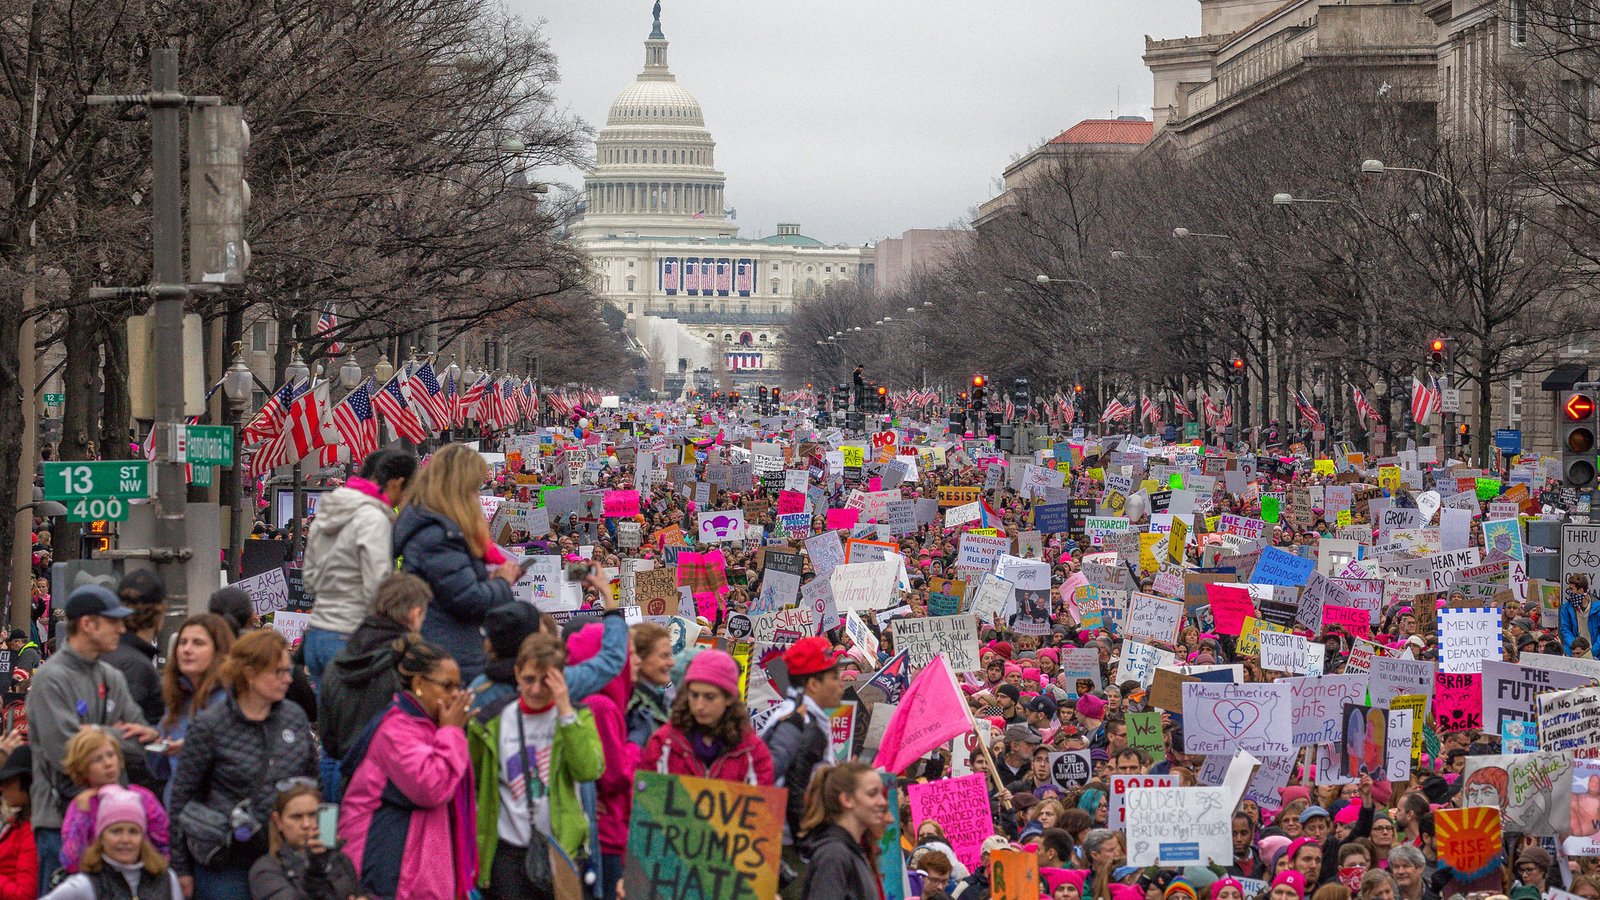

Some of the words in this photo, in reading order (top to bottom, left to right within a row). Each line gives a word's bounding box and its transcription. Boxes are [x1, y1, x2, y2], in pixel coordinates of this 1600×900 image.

[873, 431, 896, 448] HO
[59, 466, 93, 494] 13
[120, 469, 139, 479] ST
[1041, 470, 1057, 479] NEED
[1109, 476, 1131, 486] GRAB
[120, 483, 141, 493] NW
[938, 491, 980, 502] RESIST
[1356, 491, 1382, 503] LOVE
[73, 500, 122, 518] 400
[1087, 518, 1129, 530] PATRIARCHY
[1222, 515, 1239, 526] WE
[1245, 518, 1263, 530] ARE
[965, 536, 1007, 548] AMERICANS
[1567, 530, 1598, 543] THRU
[773, 553, 792, 564] HATE
[963, 546, 981, 554] WILL
[982, 547, 996, 556] NOT
[966, 555, 990, 565] RULED
[1267, 551, 1299, 570] checks
[1431, 554, 1455, 570] HEAR
[1457, 552, 1476, 566] ME
[636, 569, 664, 580] RESPETA
[667, 567, 676, 577] MI
[1106, 563, 1126, 586] SHE
[1263, 561, 1304, 583] balances
[1462, 563, 1500, 578] WOMEN
[258, 568, 284, 590] ARE
[1388, 579, 1398, 587] We
[251, 588, 268, 600] THE
[641, 586, 648, 594] O
[651, 582, 674, 593] ESPERA
[1076, 587, 1089, 598] HERE
[1311, 575, 1345, 604] MAKE
[1363, 580, 1383, 594] TINY
[1353, 599, 1368, 608] OFF
[1369, 598, 1380, 610] MY
[1325, 608, 1367, 623] ETHICS
[277, 620, 295, 628] HEAR
[894, 620, 925, 635] WHEN
[929, 619, 945, 632] DID
[951, 618, 967, 631] THE
[1447, 620, 1475, 631] MEN
[1477, 620, 1489, 631] OF
[896, 631, 948, 645] DOLLAR
[1261, 631, 1294, 649] DIVERSITY
[1296, 637, 1304, 651] IS
[1447, 636, 1491, 648] QUALITY
[940, 641, 964, 652] MORE
[1129, 642, 1162, 666] Liberty
[1447, 648, 1491, 660] DEMAND
[949, 650, 970, 660] THAN
[1266, 646, 1307, 673] beautiful
[1379, 661, 1400, 673] STOP
[1401, 662, 1430, 679] TRYING
[1521, 667, 1550, 683] THE
[1389, 675, 1417, 684] CONTROL
[1436, 673, 1474, 689] GRAB
[1188, 684, 1220, 699] Making
[1223, 684, 1282, 699] America
[1543, 705, 1555, 714] AM
[1557, 701, 1571, 712] NO
[1572, 694, 1598, 709] LONGER
[1131, 717, 1157, 736] We
[1541, 712, 1581, 730] ACCEPTING
[1547, 726, 1576, 743] CANNOT
[1186, 734, 1230, 752] GREAT
[1262, 742, 1289, 753] 1776
[1553, 737, 1588, 753] CHANGING
[1063, 755, 1077, 764] END
[1513, 759, 1538, 785] Pussy
[930, 781, 951, 793] THE
[957, 777, 982, 789] TRUE
[920, 786, 985, 806] GREATNESS
[1127, 790, 1185, 811] GOLDEN
[664, 781, 764, 829] LOVE
[922, 805, 934, 817] OF
[937, 805, 946, 814] A
[949, 797, 987, 812] NATION
[975, 808, 989, 817] ON
[976, 817, 986, 828] OF
[1130, 805, 1192, 826] SHOWERS
[1131, 823, 1169, 838] BRING
[638, 822, 768, 868] TRUMPS
[1450, 838, 1486, 856] RISE
[1456, 854, 1483, 871] UP!
[650, 863, 756, 900] HATE
